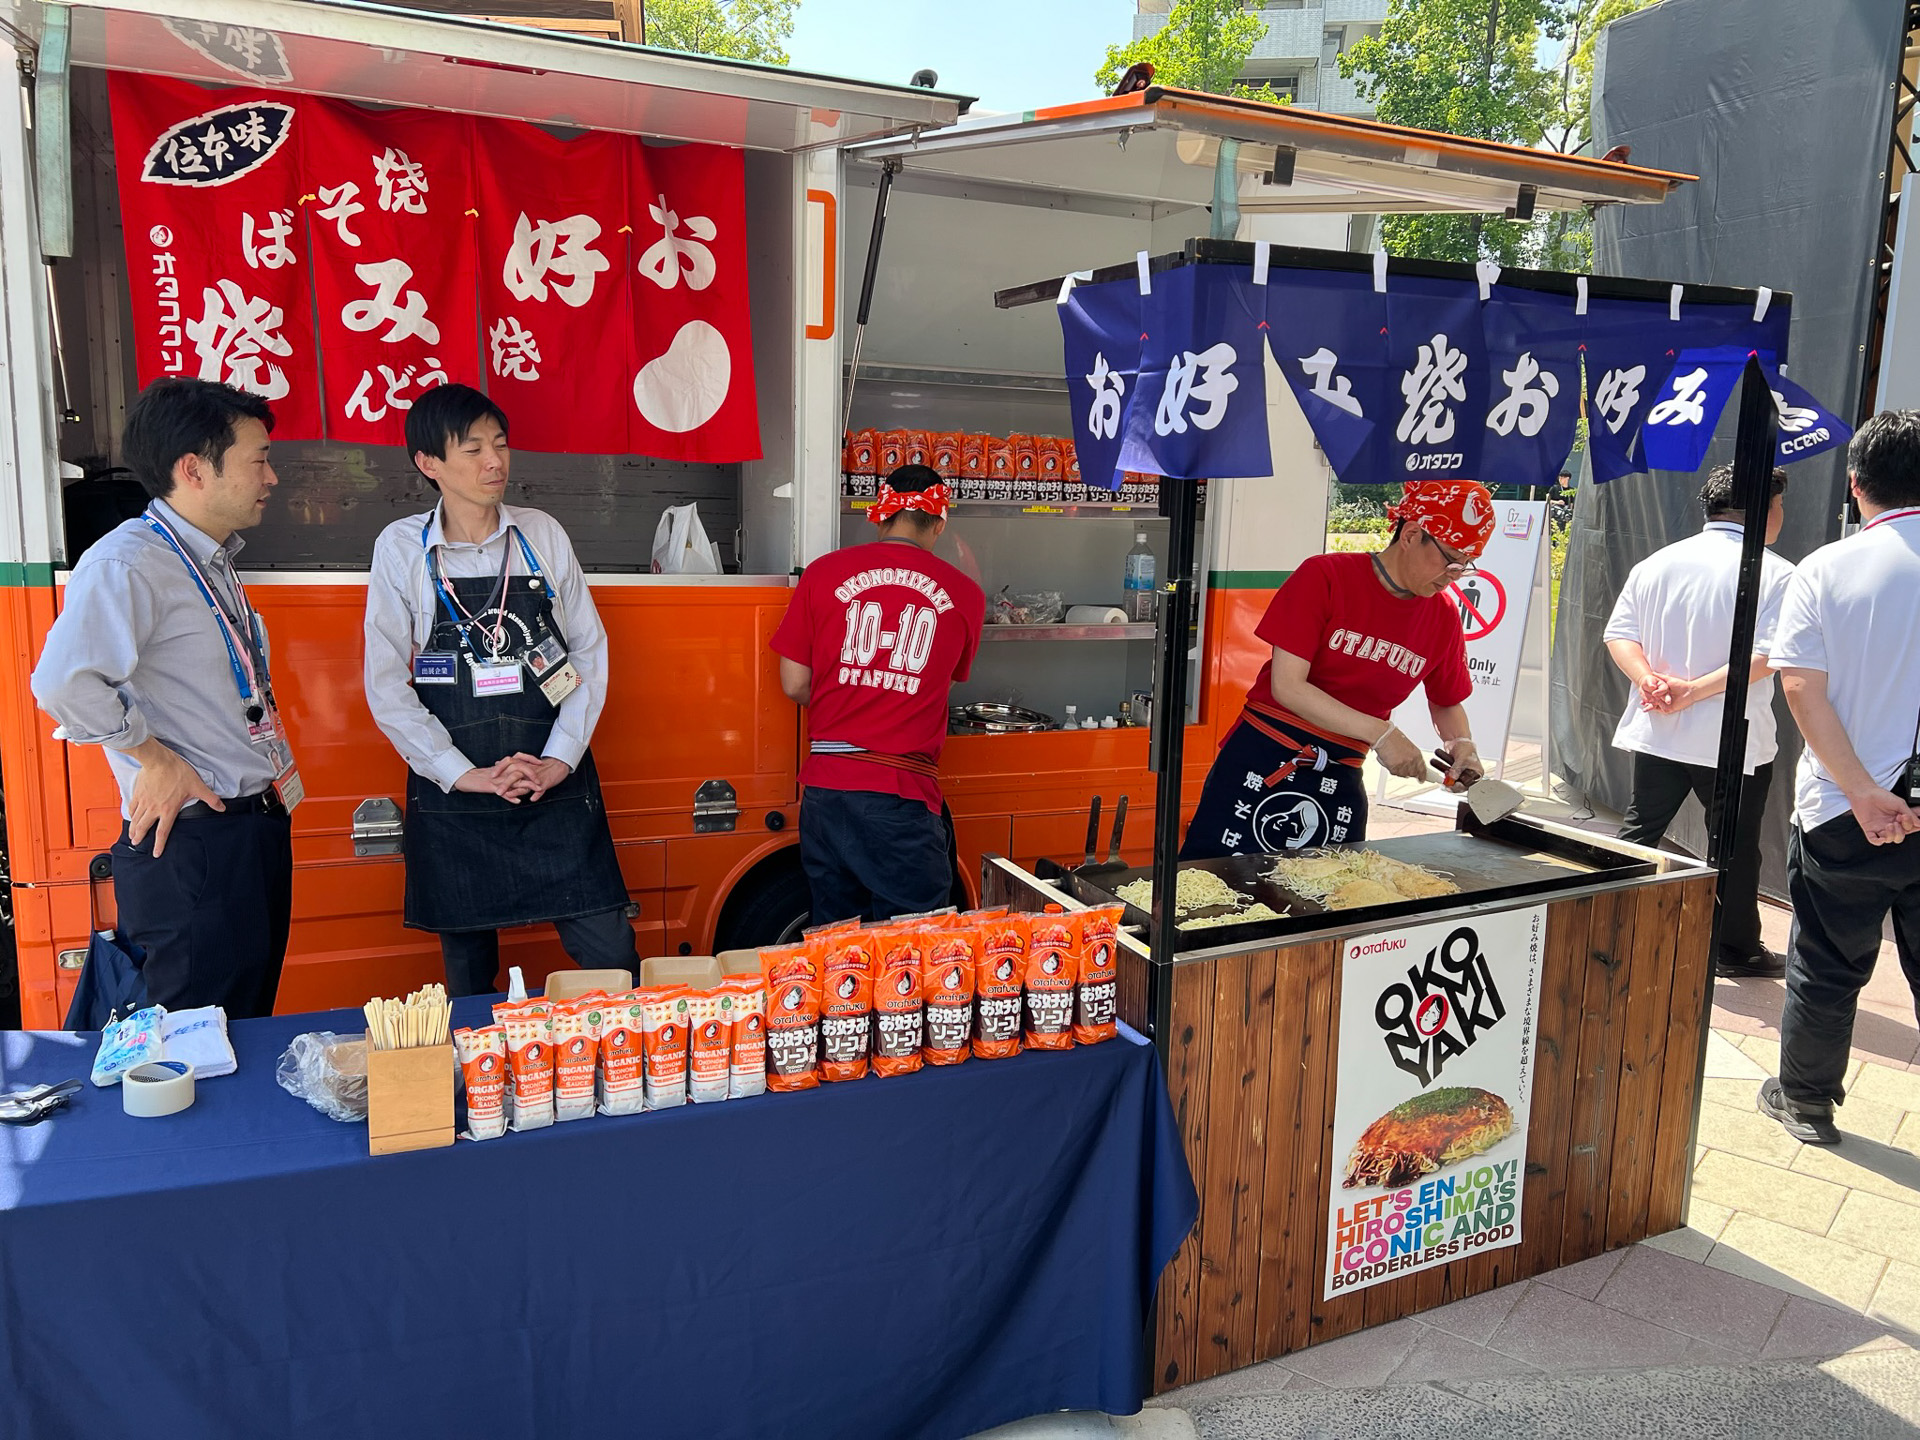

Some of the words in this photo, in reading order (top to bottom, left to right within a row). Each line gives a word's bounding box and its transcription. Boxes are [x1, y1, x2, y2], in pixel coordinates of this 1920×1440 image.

[1418, 453, 1463, 470] オタフク
[834, 568, 955, 614] OKONOMIYAKI
[840, 599, 938, 675] 10-10
[1328, 628, 1427, 679] OTAFUKU
[1469, 657, 1497, 675] Only
[838, 667, 921, 695] OTAFUKU
[979, 996, 1022, 1017] お好み
[1027, 992, 1074, 1009] お好み
[821, 1015, 870, 1036] お好み
[879, 1012, 922, 1031] お好み
[927, 1003, 972, 1024] お好み
[768, 1026, 819, 1048] お好み
[1336, 1188, 1413, 1230] LET'S
[1418, 1159, 1518, 1206] ENJOY!
[1336, 1180, 1517, 1251] HIROSHIMA'S
[1333, 1222, 1445, 1276] ICONIC
[1450, 1202, 1516, 1241] AND
[1332, 1239, 1460, 1291] BORDERLESS
[1463, 1223, 1515, 1251] FOOD
